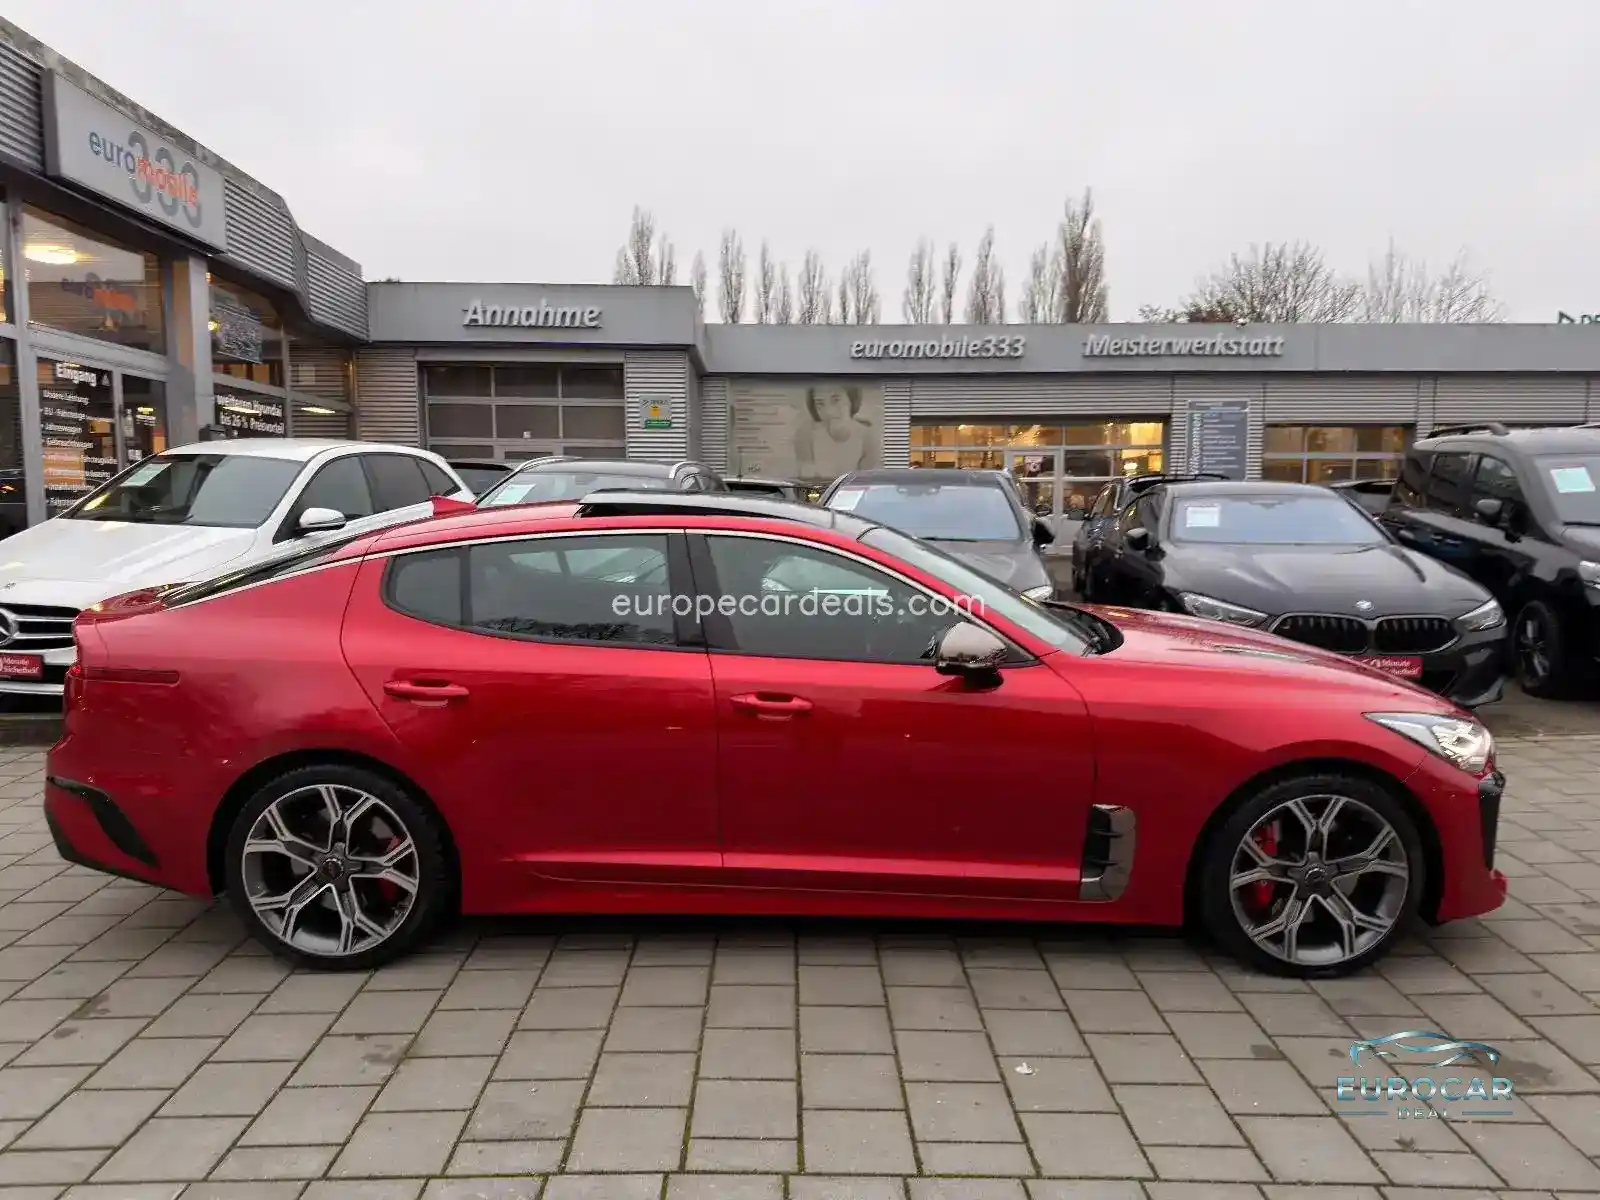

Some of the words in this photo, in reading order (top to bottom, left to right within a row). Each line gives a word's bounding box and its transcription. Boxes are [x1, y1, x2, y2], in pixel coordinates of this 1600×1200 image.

[463, 297, 601, 328] Annahme
[851, 333, 1026, 358] euromobile333
[1083, 332, 1285, 357] Meisterwerkstatt
